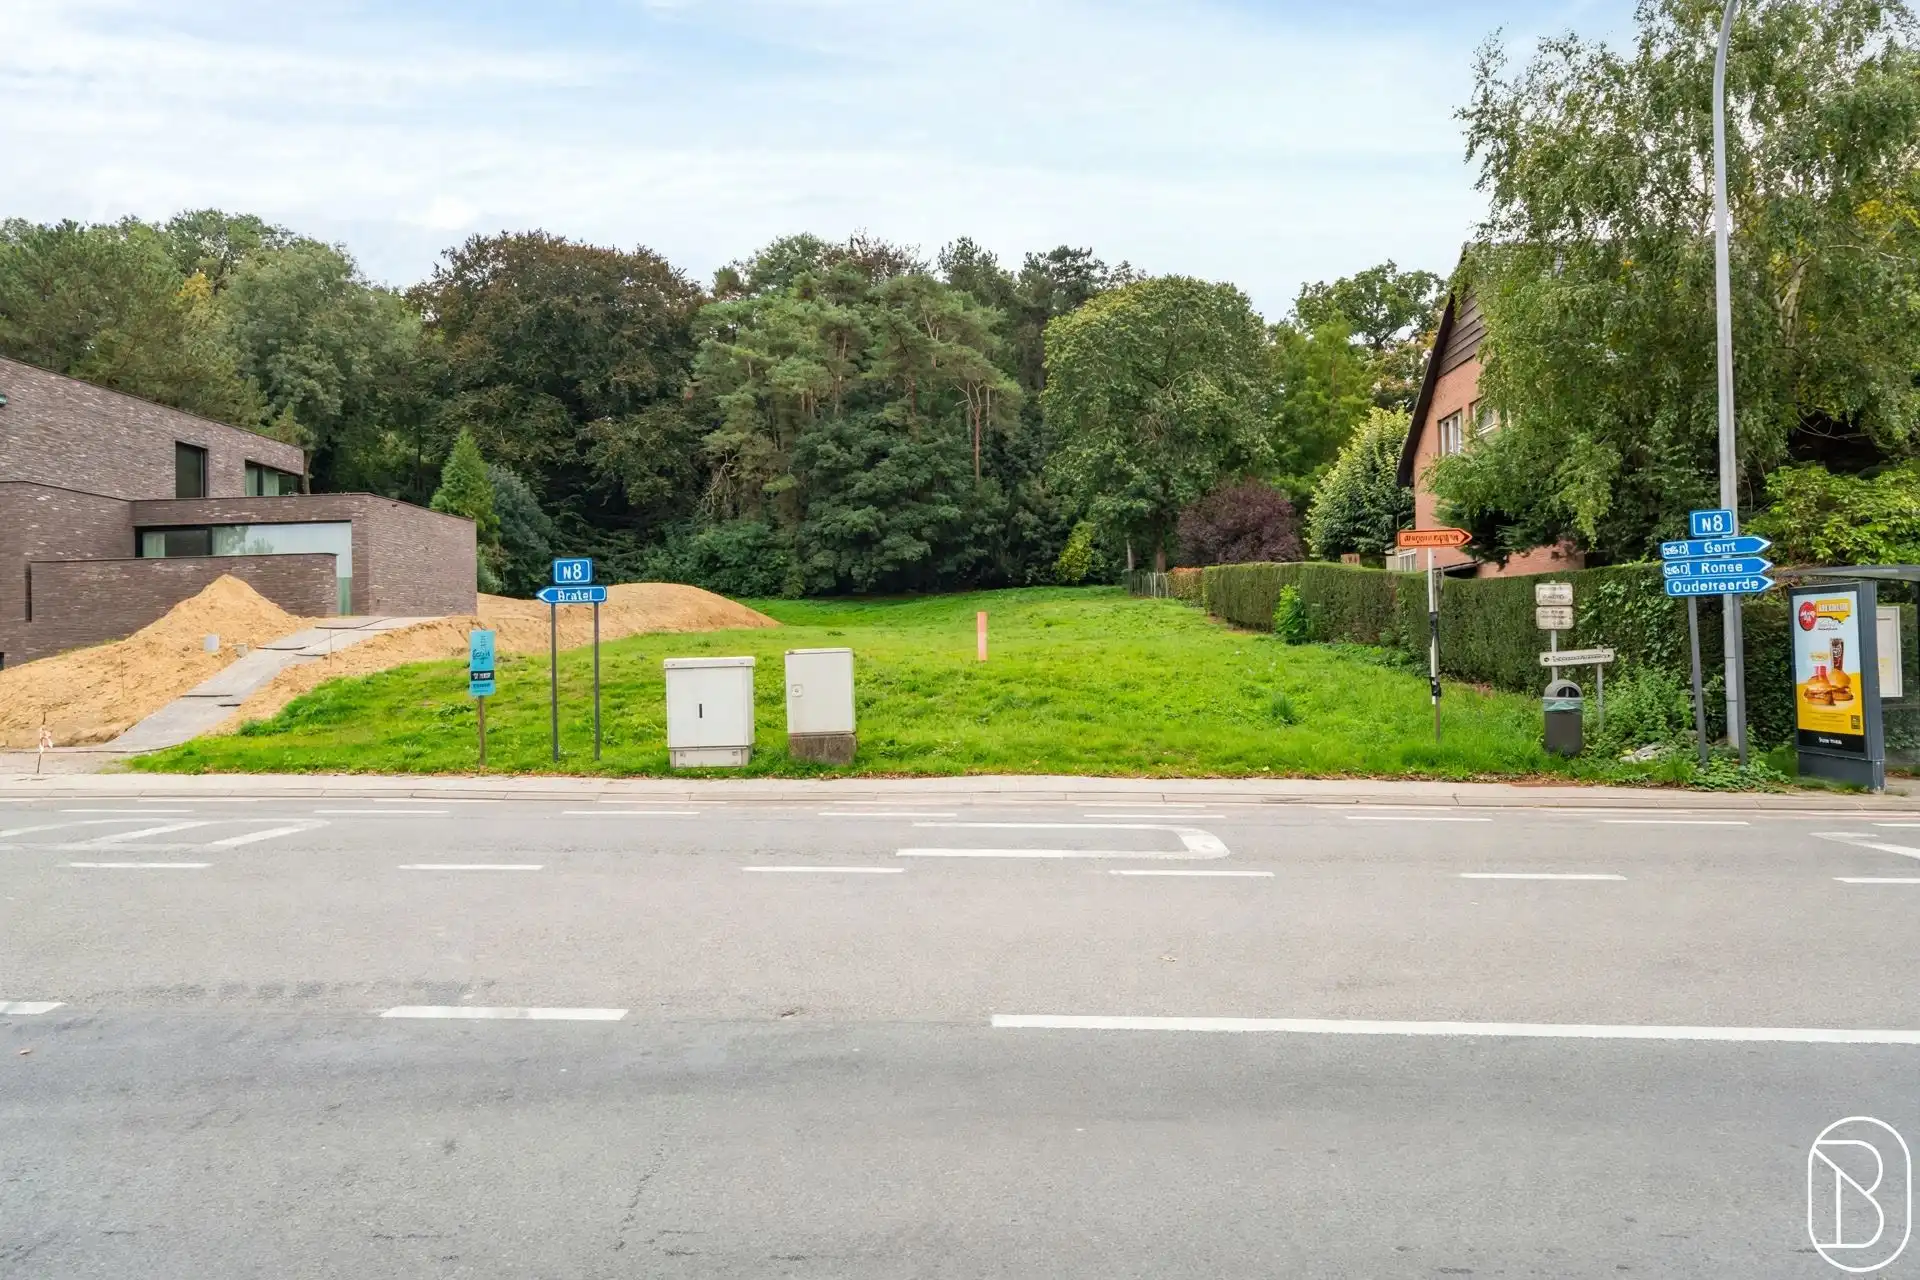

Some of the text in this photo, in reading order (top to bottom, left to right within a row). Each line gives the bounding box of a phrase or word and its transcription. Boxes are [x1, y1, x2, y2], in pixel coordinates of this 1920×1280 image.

[1702, 514, 1724, 532] N8
[563, 563, 582, 580] N8
[1701, 563, 1743, 574] Ronse
